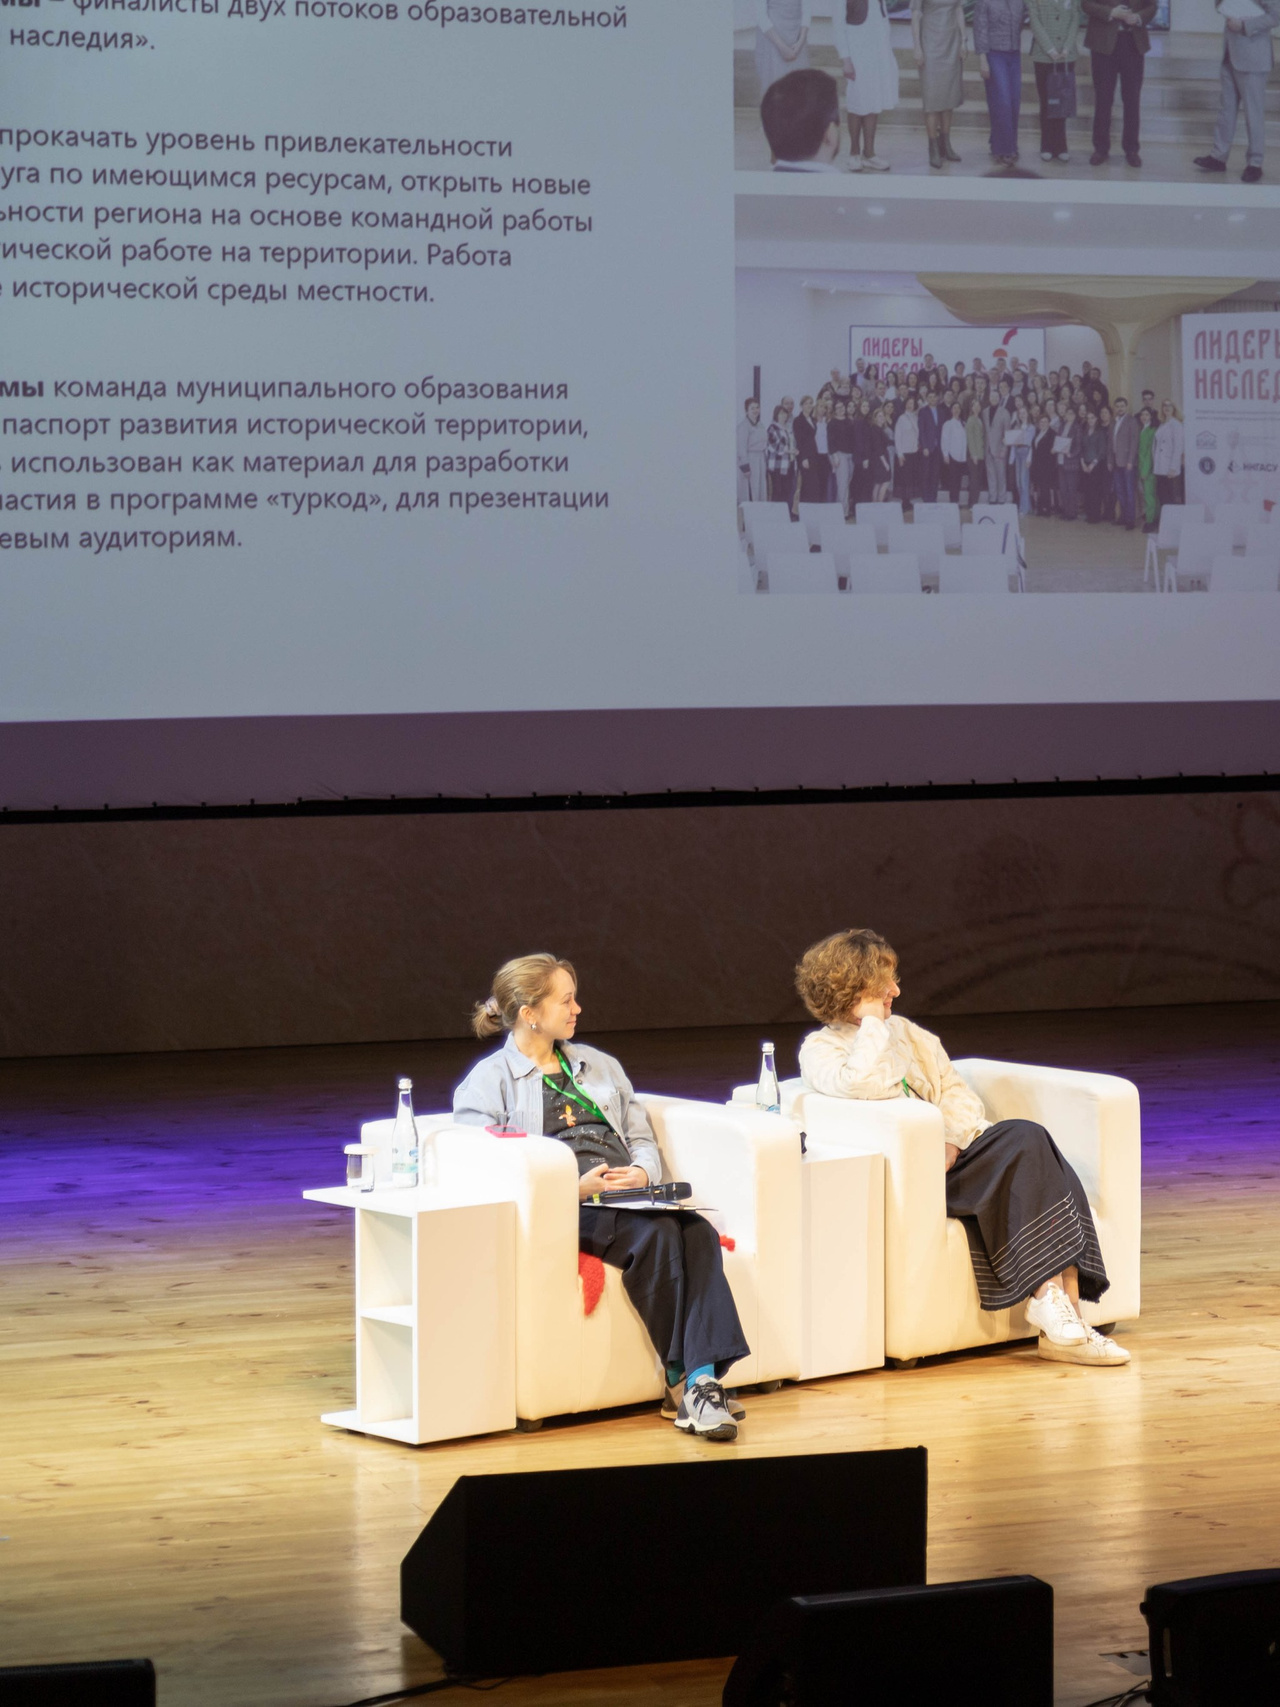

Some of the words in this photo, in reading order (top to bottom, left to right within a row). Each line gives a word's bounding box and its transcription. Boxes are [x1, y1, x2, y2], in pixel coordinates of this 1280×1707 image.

[227, 0, 286, 22] двух
[296, 0, 398, 20] потоков
[408, 0, 626, 28] образовательной
[10, 29, 154, 52] наследия».
[0, 129, 137, 152] прокачать
[146, 132, 255, 155] уровень
[265, 135, 512, 158] привлекательности
[1, 166, 39, 190] уга
[50, 167, 82, 184] по
[93, 168, 255, 190] имеющимся
[266, 172, 392, 195] ресурсам,
[401, 175, 502, 198] открыть
[513, 178, 590, 195] новые
[95, 207, 201, 229] региона
[212, 209, 240, 225] на
[250, 209, 342, 227] основе
[352, 207, 492, 232] командной
[503, 208, 592, 236] работы
[0, 237, 111, 260] ической
[122, 237, 212, 267] работе
[222, 246, 250, 262] на
[259, 246, 417, 270] территории.
[428, 243, 511, 266] Работа
[13, 276, 197, 305] исторической
[208, 283, 286, 306] среды
[298, 284, 434, 302] местности.
[862, 336, 923, 359] ЛИДЕРЫ
[0, 381, 44, 397] мы
[54, 381, 166, 401] команда
[177, 381, 396, 404] муниципального
[404, 375, 567, 405] образования
[3, 418, 111, 441] паспорт
[120, 418, 237, 441] развития
[248, 412, 425, 441] исторической
[435, 419, 587, 441] территории,
[12, 456, 181, 473] использован
[193, 456, 234, 472] как
[244, 456, 364, 478] материал
[372, 456, 416, 475] для
[426, 449, 568, 478] разработки
[0, 493, 76, 511] астия
[87, 493, 100, 510] в
[111, 493, 258, 516] программе
[267, 492, 387, 515] «туркод»,
[396, 492, 439, 512] для
[450, 492, 608, 514] презентации
[0, 532, 69, 549] евым
[79, 530, 241, 555] аудиториям.
